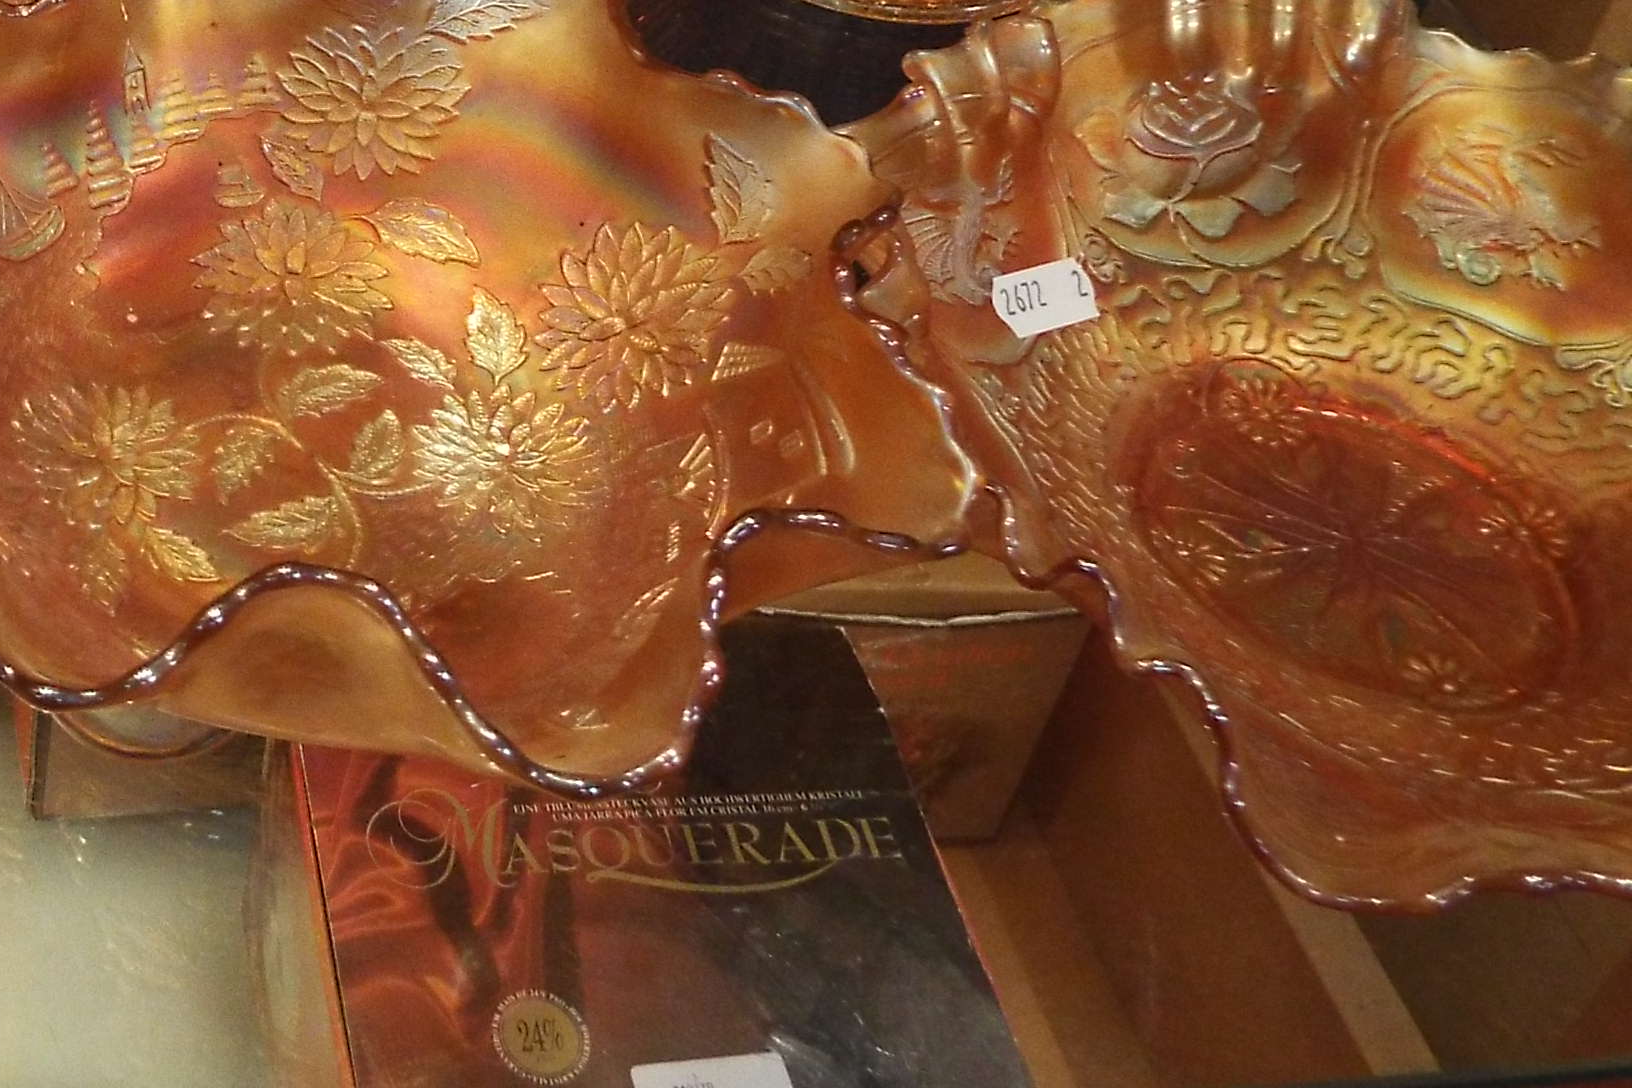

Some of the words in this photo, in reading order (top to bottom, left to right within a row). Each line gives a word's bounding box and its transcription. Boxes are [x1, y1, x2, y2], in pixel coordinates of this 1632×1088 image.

[999, 280, 1048, 316] 2672
[366, 788, 903, 893] MASQUERADE
[515, 1017, 565, 1053] 24%
